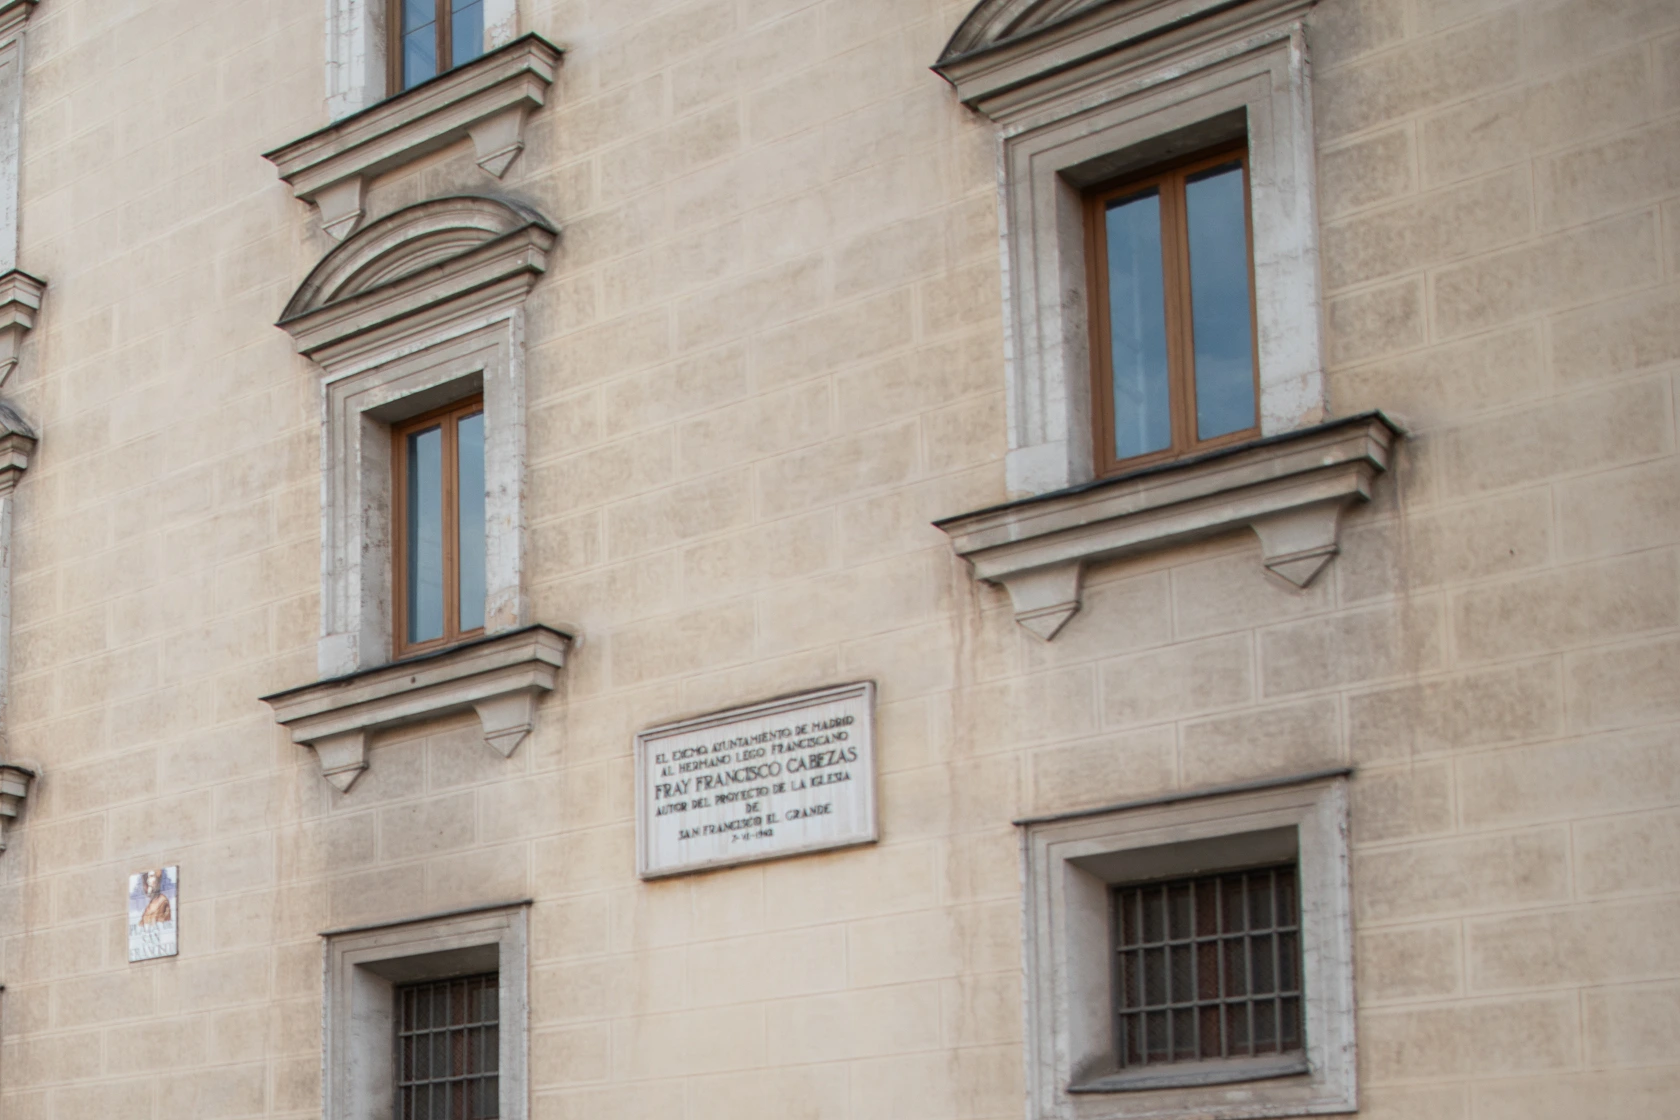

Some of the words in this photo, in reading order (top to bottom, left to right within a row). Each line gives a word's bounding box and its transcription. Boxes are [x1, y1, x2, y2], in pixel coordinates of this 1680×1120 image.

[655, 753, 668, 764] EL
[711, 728, 792, 753] AYUNTAMIENTO
[795, 724, 808, 736] DE
[812, 715, 855, 732] MADRID
[661, 766, 674, 777] AL
[679, 755, 731, 774] HERMANO
[736, 748, 766, 762] LEGO
[771, 731, 848, 755] FRANCISCANO
[655, 778, 691, 800] FRAY
[695, 761, 782, 792] FRANCISCO
[786, 746, 858, 774] CABEZAS
[655, 801, 687, 817] AUTOR
[691, 798, 711, 809] DEL
[715, 786, 769, 805] PROYECTO
[773, 783, 786, 794] DE
[791, 780, 806, 791] LA
[810, 771, 851, 787] IGLESIA
[678, 828, 700, 841] SAN
[702, 816, 762, 836] FRANCISCO
[766, 813, 780, 825] EL
[785, 803, 832, 821] GRANDE
[746, 802, 759, 814] DE
